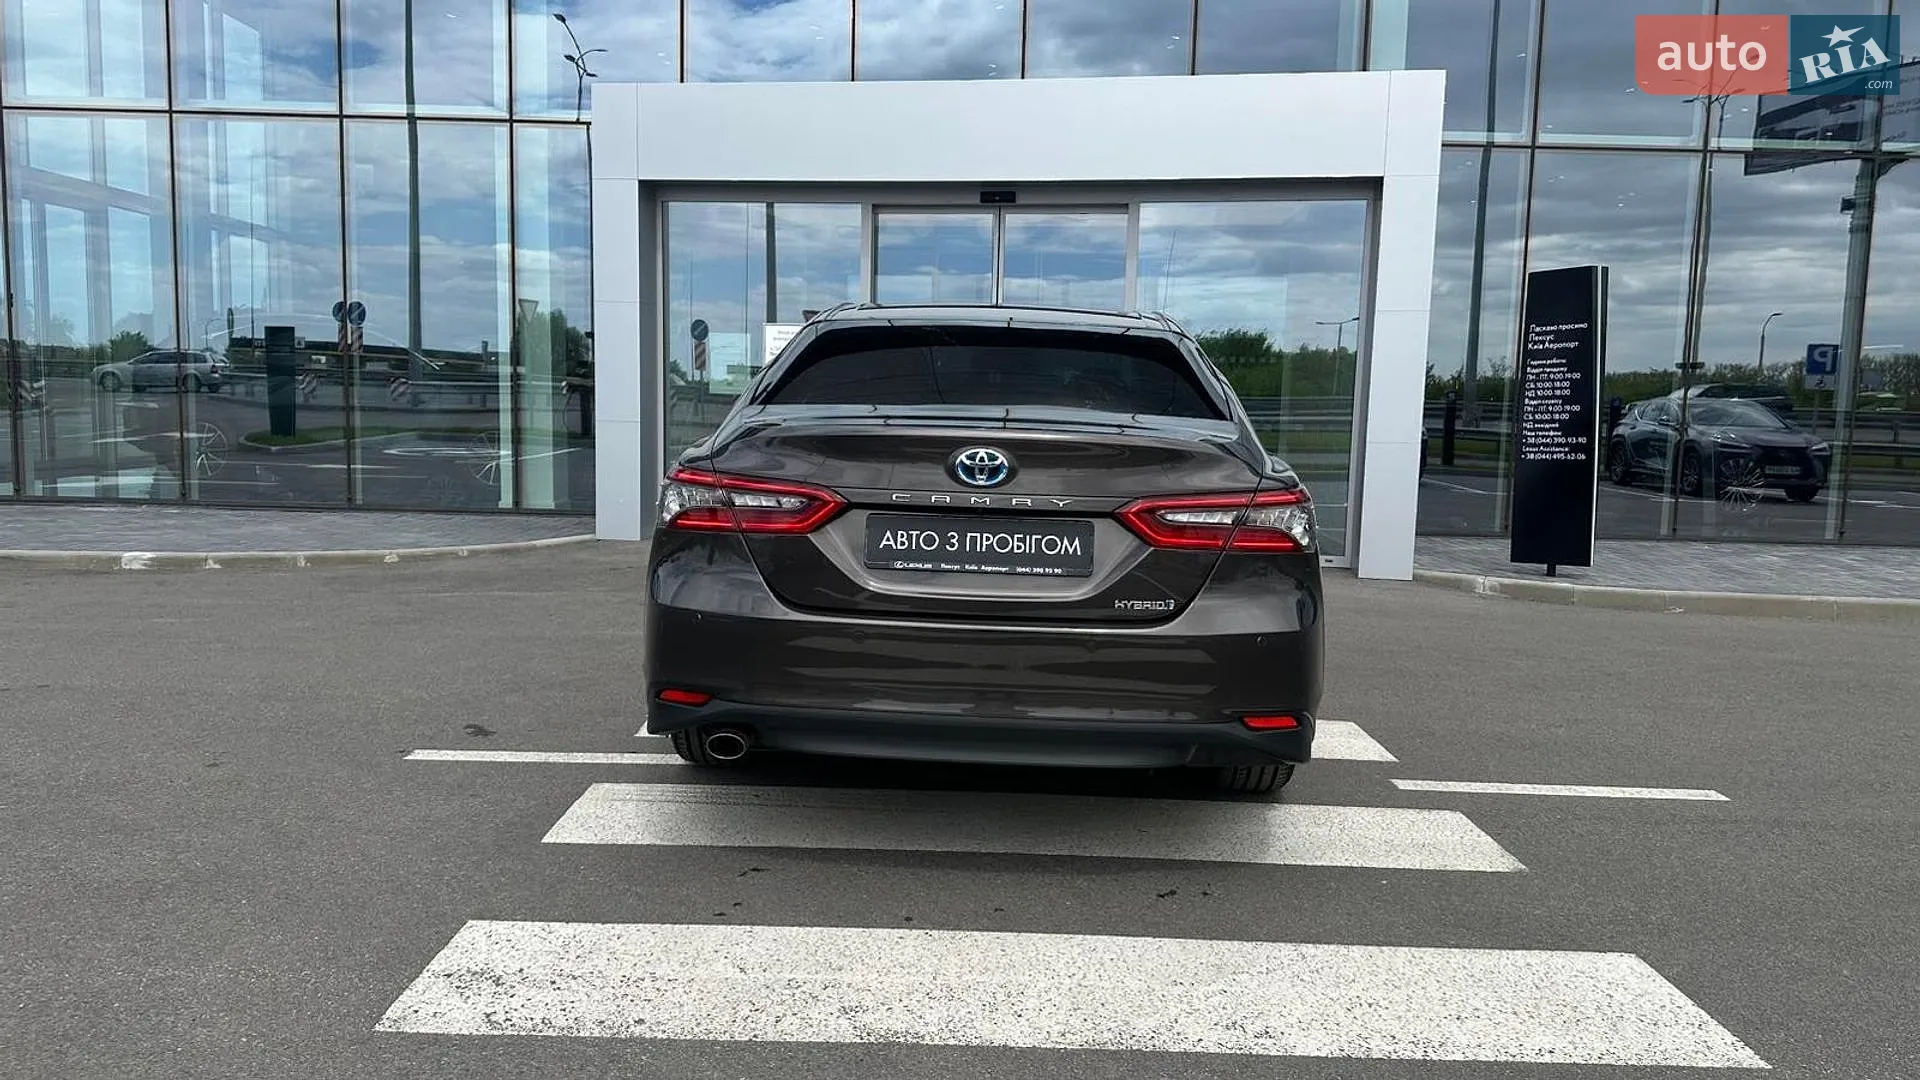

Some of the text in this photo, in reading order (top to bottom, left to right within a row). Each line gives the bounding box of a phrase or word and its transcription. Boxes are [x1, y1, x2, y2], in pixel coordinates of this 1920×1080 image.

[1544, 341, 1580, 351] Аеропорт
[892, 493, 1072, 508] CAMRY
[879, 530, 939, 551] АВТО
[966, 532, 1081, 556] ПРОБІГОМ
[1114, 600, 1165, 610] HYBRID
